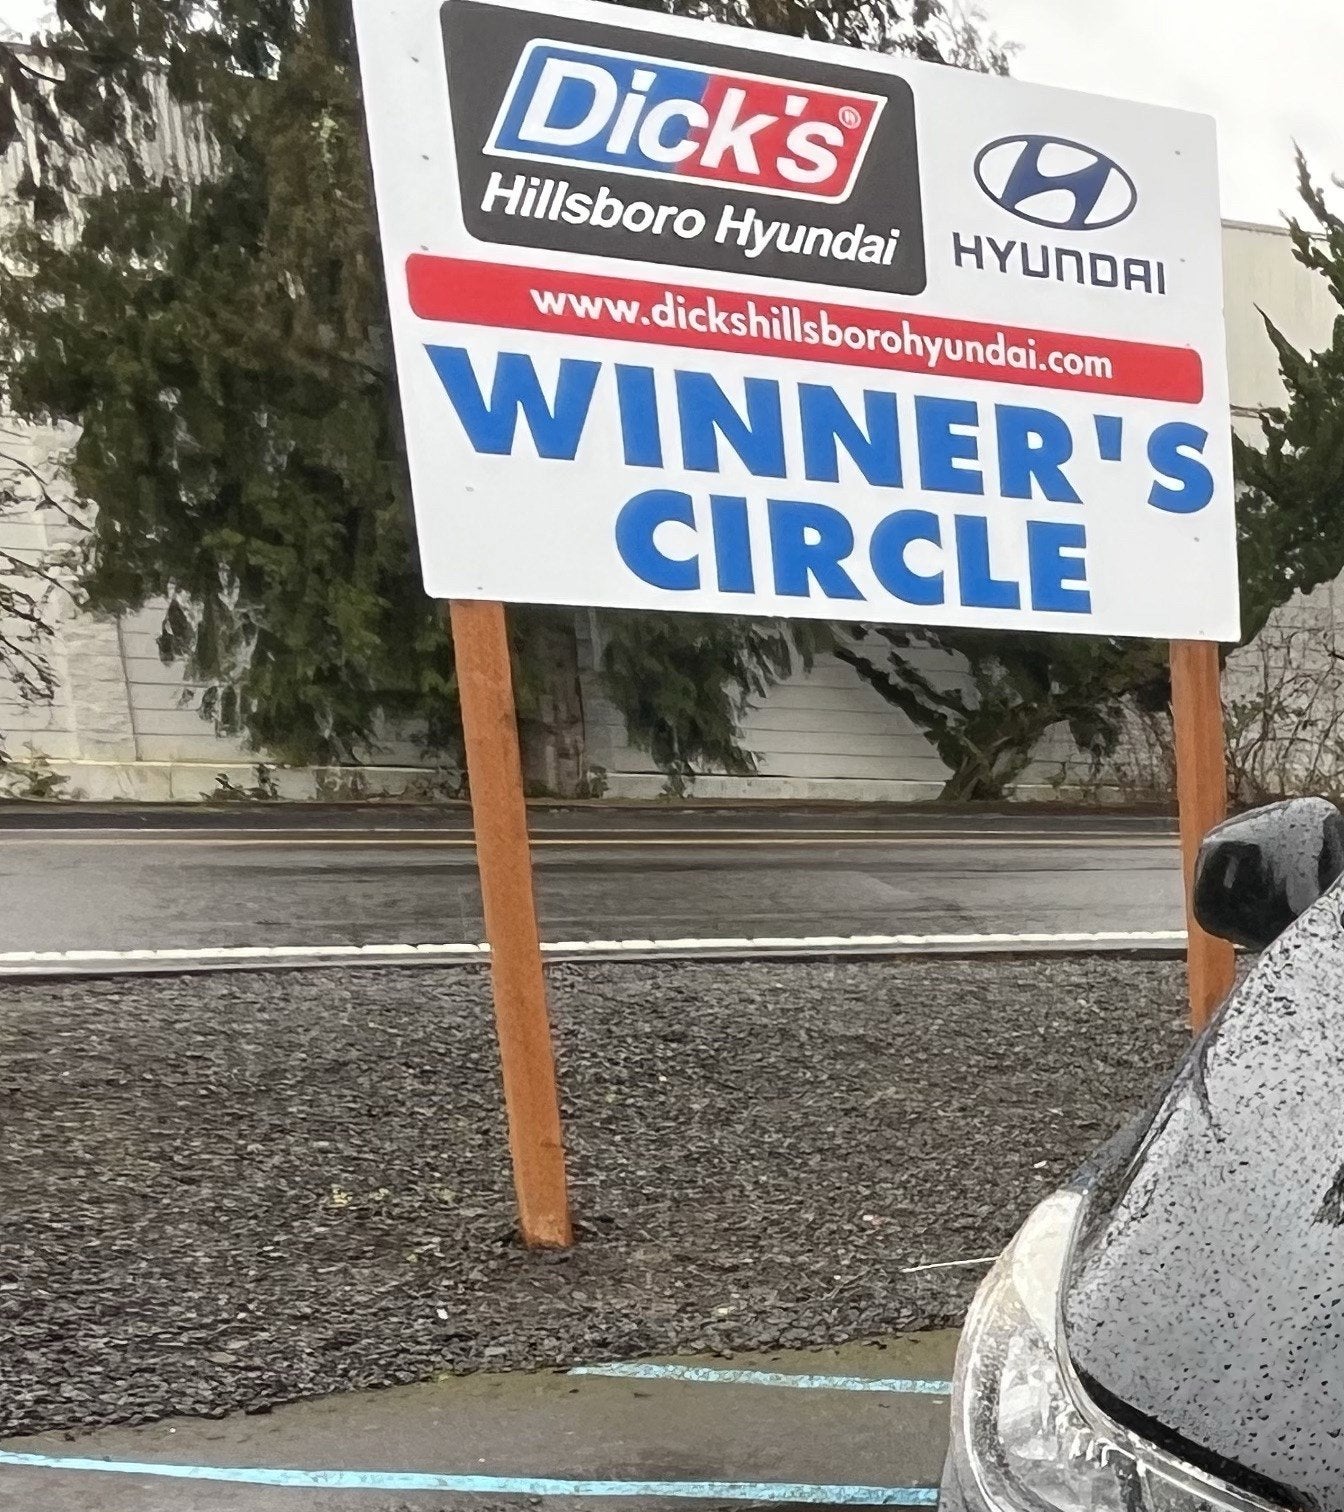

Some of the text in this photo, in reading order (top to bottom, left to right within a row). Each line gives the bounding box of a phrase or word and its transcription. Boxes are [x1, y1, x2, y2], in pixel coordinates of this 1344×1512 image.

[519, 58, 844, 184] Dick's
[481, 172, 900, 265] Hillsboro Hyundai
[953, 231, 1166, 296] HYUNDAI
[530, 286, 1113, 381] www.dickshillsborohyundai.com
[425, 344, 1215, 514] WINNER'S
[616, 489, 1093, 614] CIRCLE
